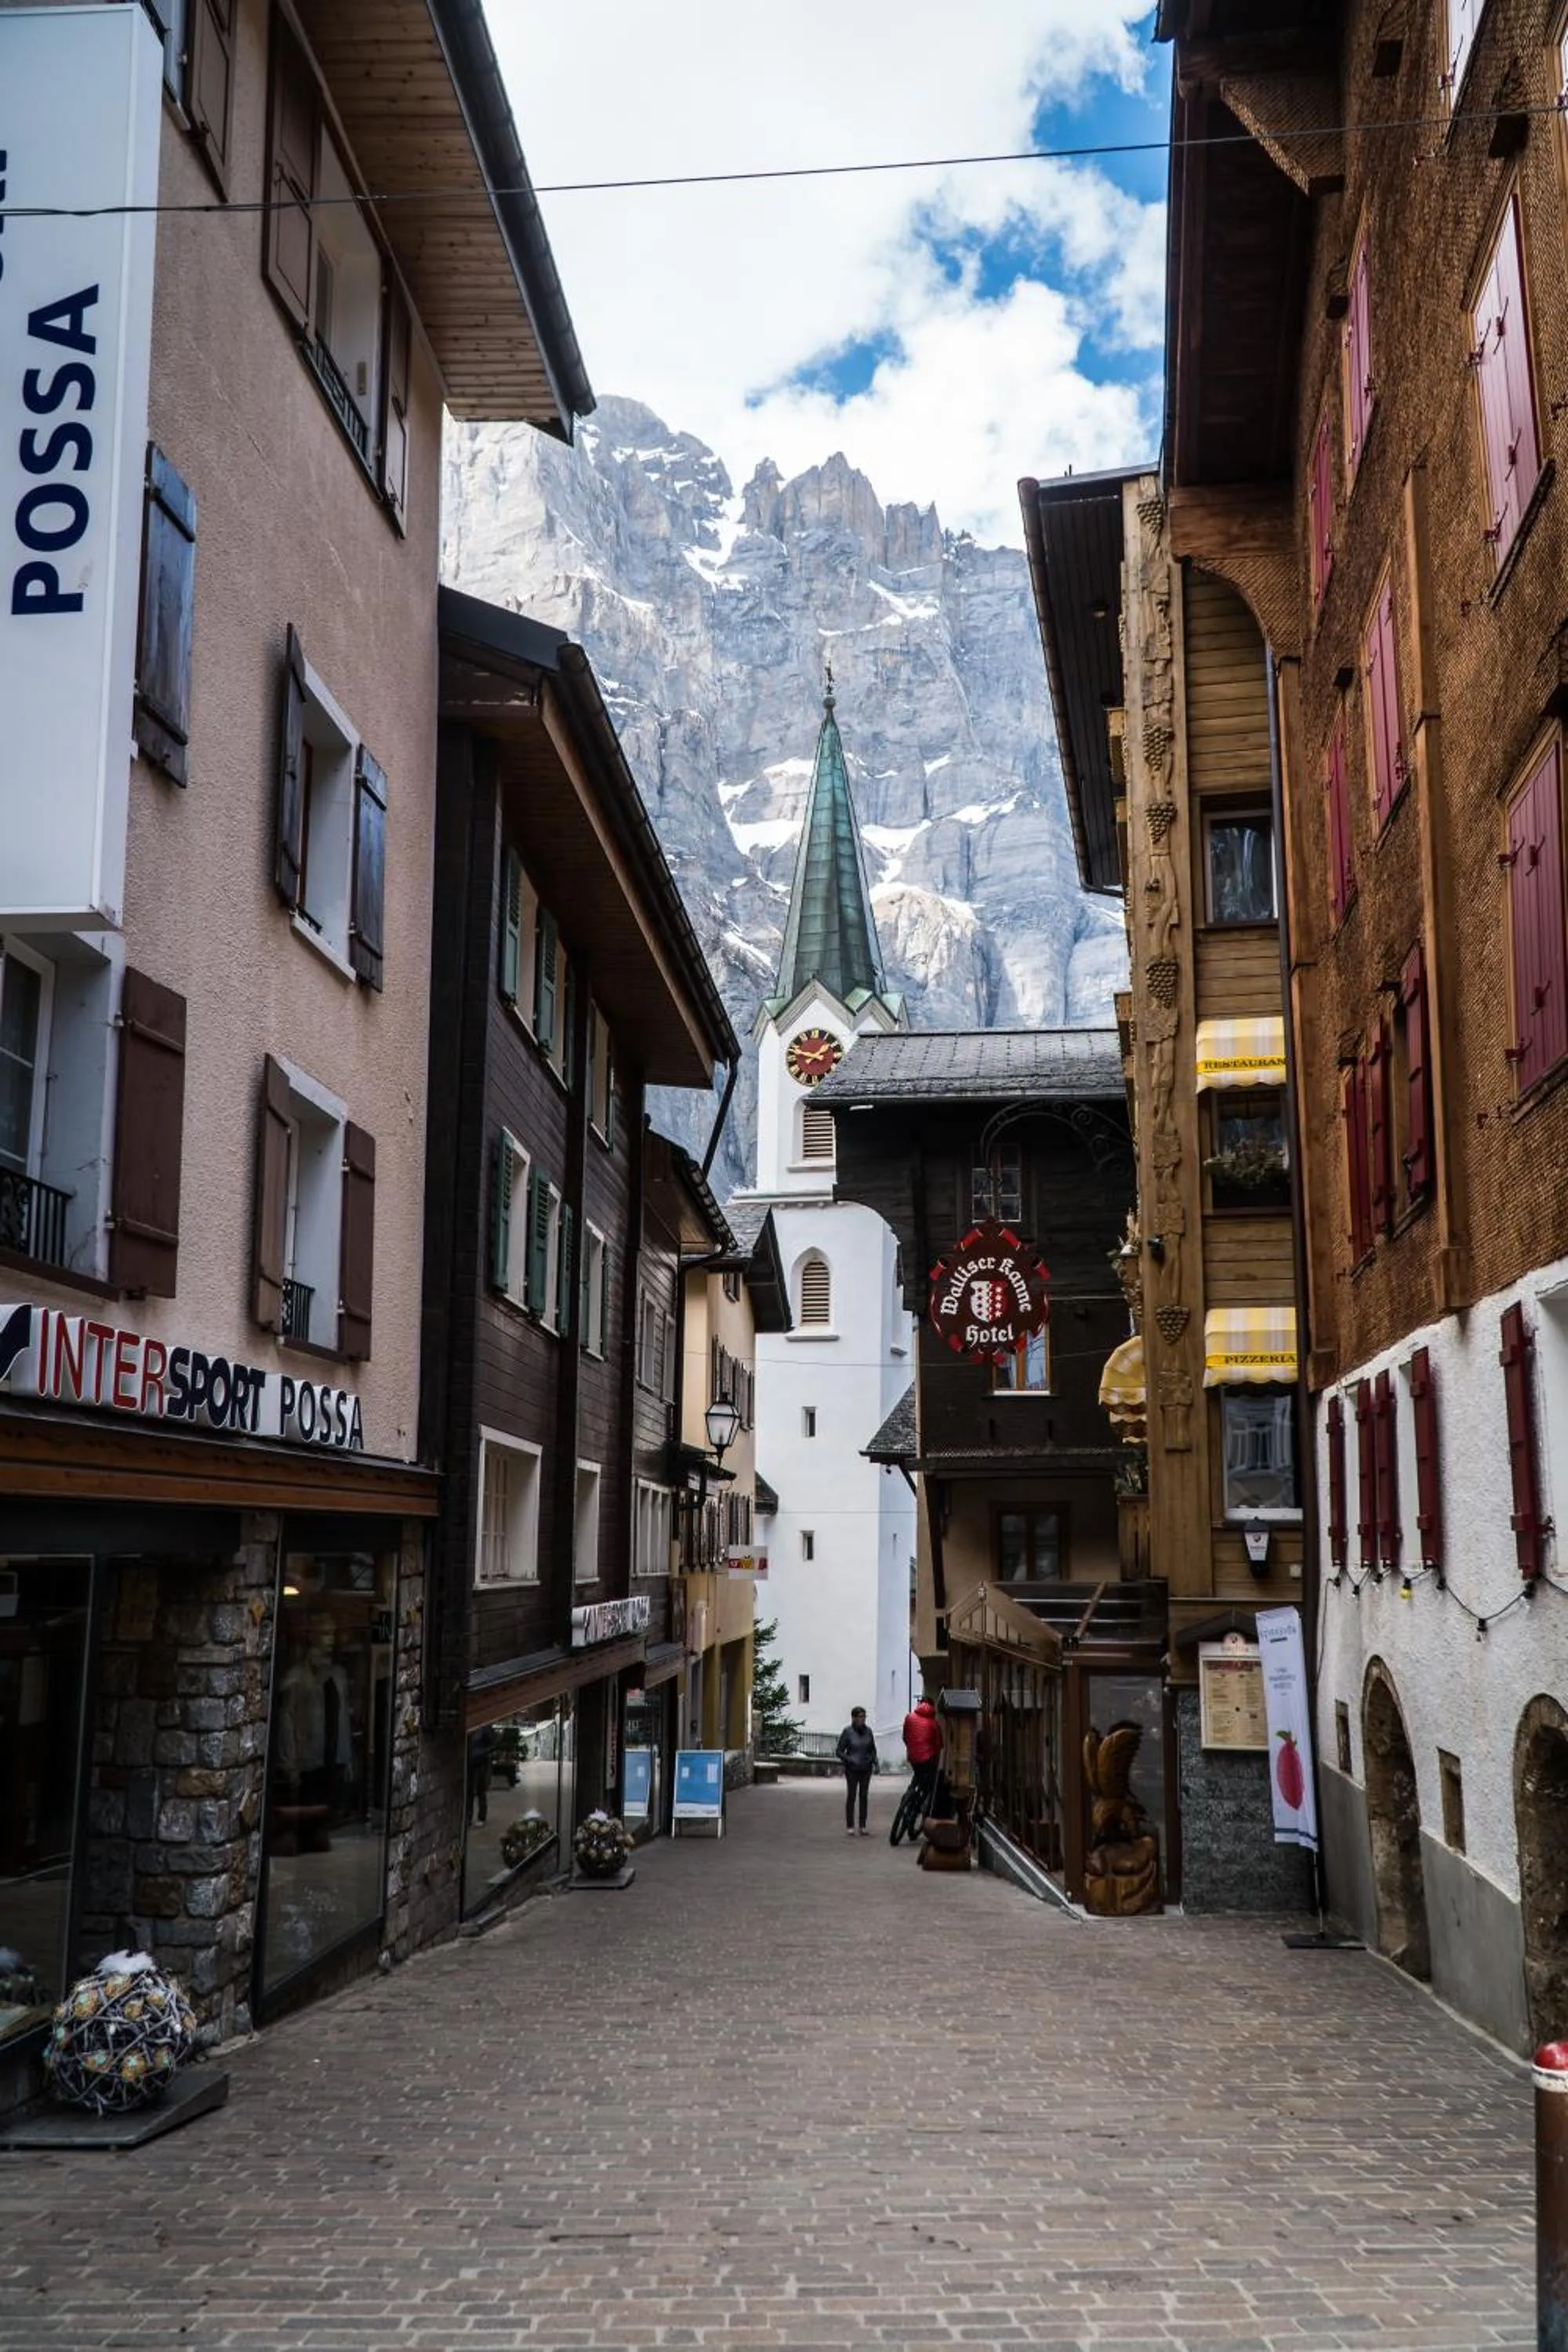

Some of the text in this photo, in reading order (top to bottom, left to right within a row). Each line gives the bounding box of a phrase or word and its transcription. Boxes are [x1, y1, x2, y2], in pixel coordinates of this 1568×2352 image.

[11, 283, 100, 615] POSSA
[1204, 1058, 1286, 1069] RESTAURAN
[966, 1323, 1014, 1347] Hotel
[1225, 1354, 1298, 1363] PIZZERIA
[38, 1307, 365, 1450] INTERSPORT POSSA
